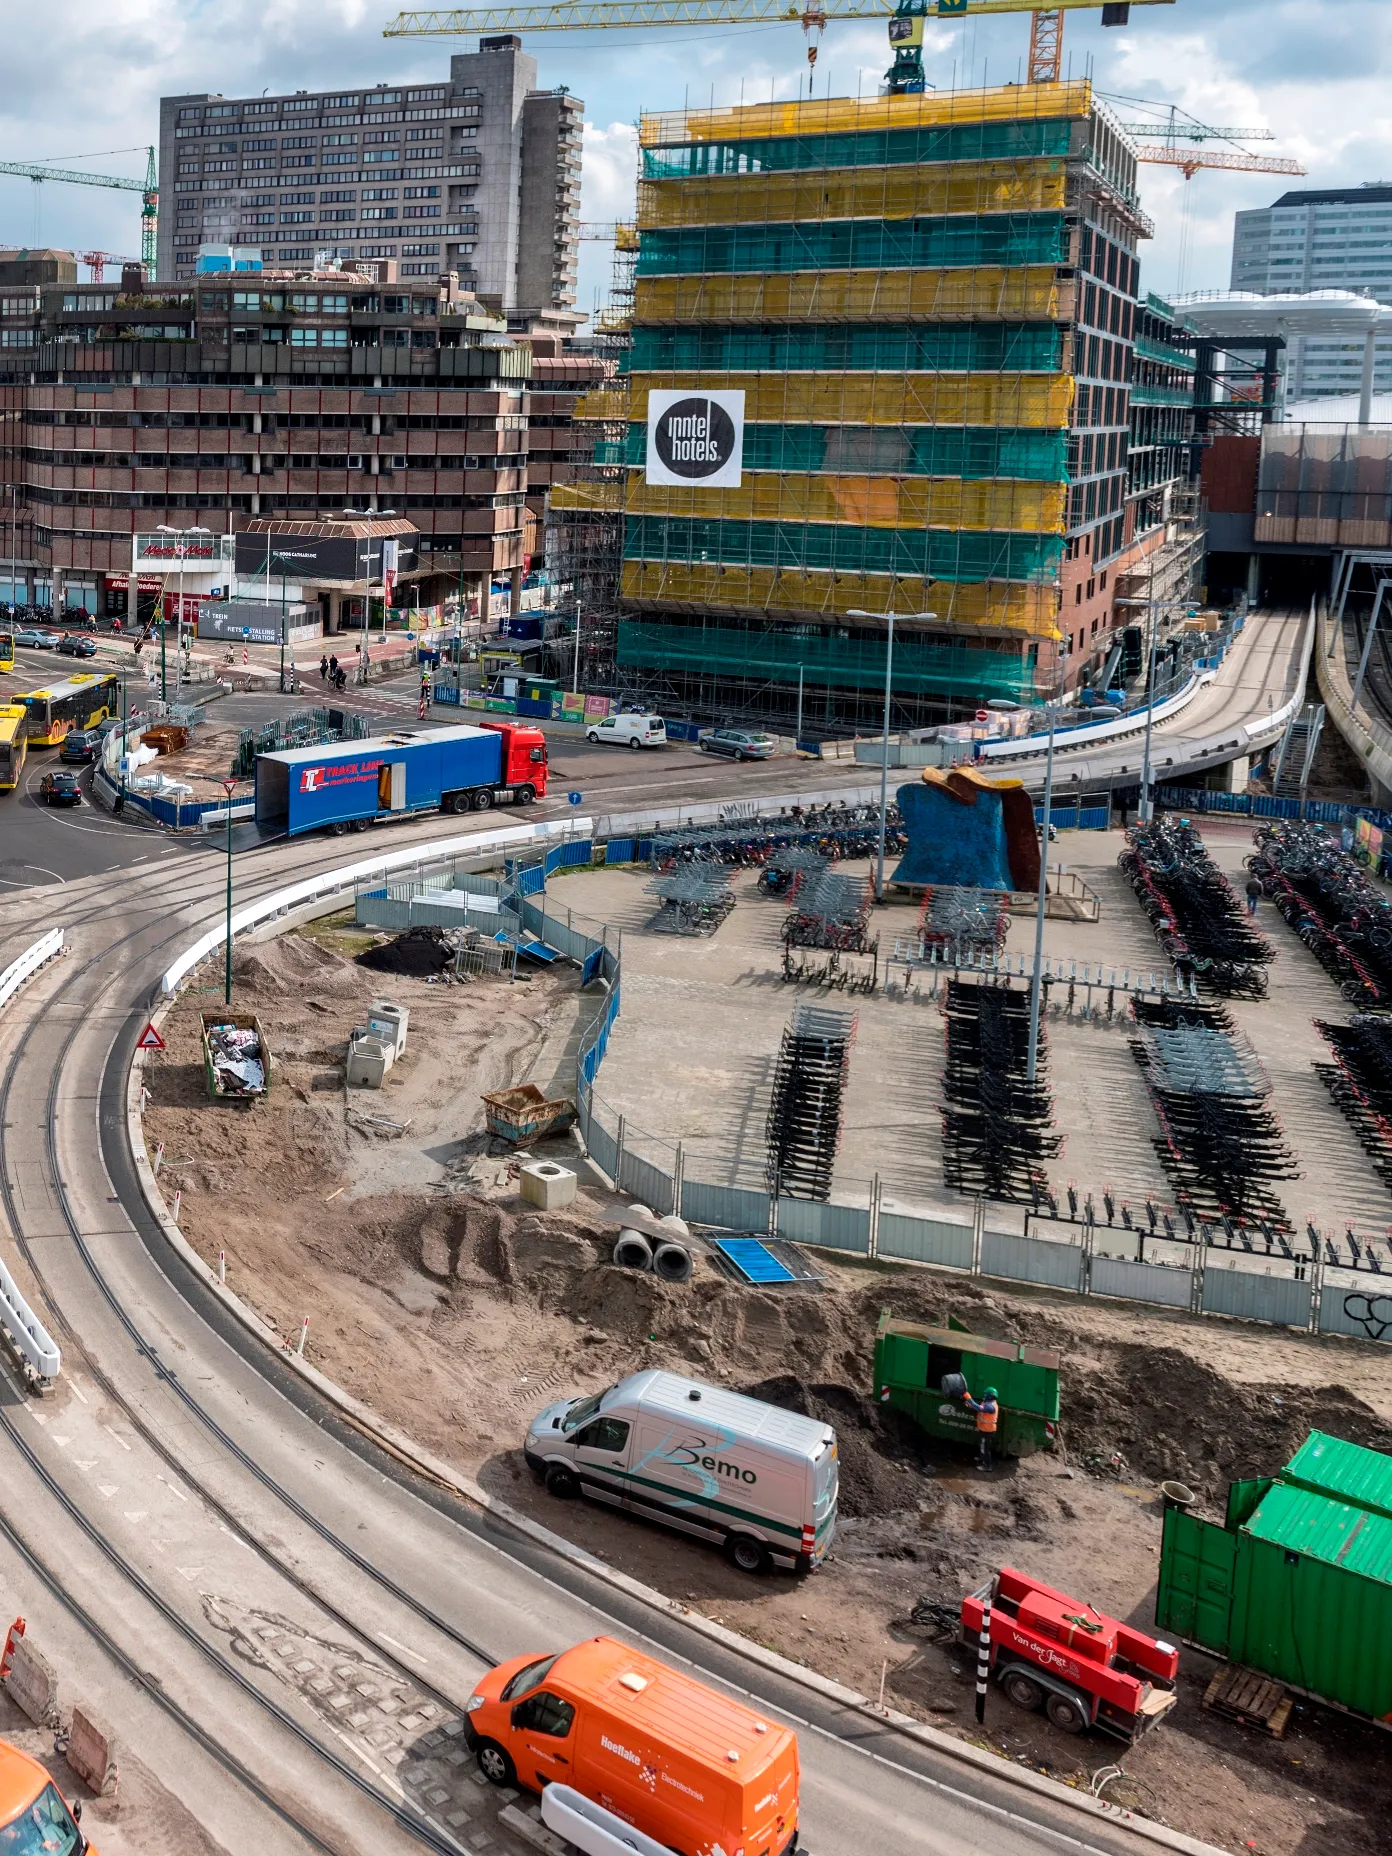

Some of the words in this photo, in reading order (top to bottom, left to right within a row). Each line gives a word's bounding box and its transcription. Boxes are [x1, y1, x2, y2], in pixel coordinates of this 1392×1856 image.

[667, 399, 711, 438] inntel
[672, 437, 718, 461] hotels
[142, 544, 176, 556] Media
[183, 544, 214, 556] Markt
[326, 763, 359, 778] TRACK
[658, 1434, 758, 1486] Bemo
[1012, 1631, 1029, 1647] Van
[1030, 1642, 1046, 1657] der
[1038, 1649, 1068, 1667] Jagt
[600, 1734, 641, 1766] Hoeflake
[660, 1771, 705, 1803] Electrotechniek
